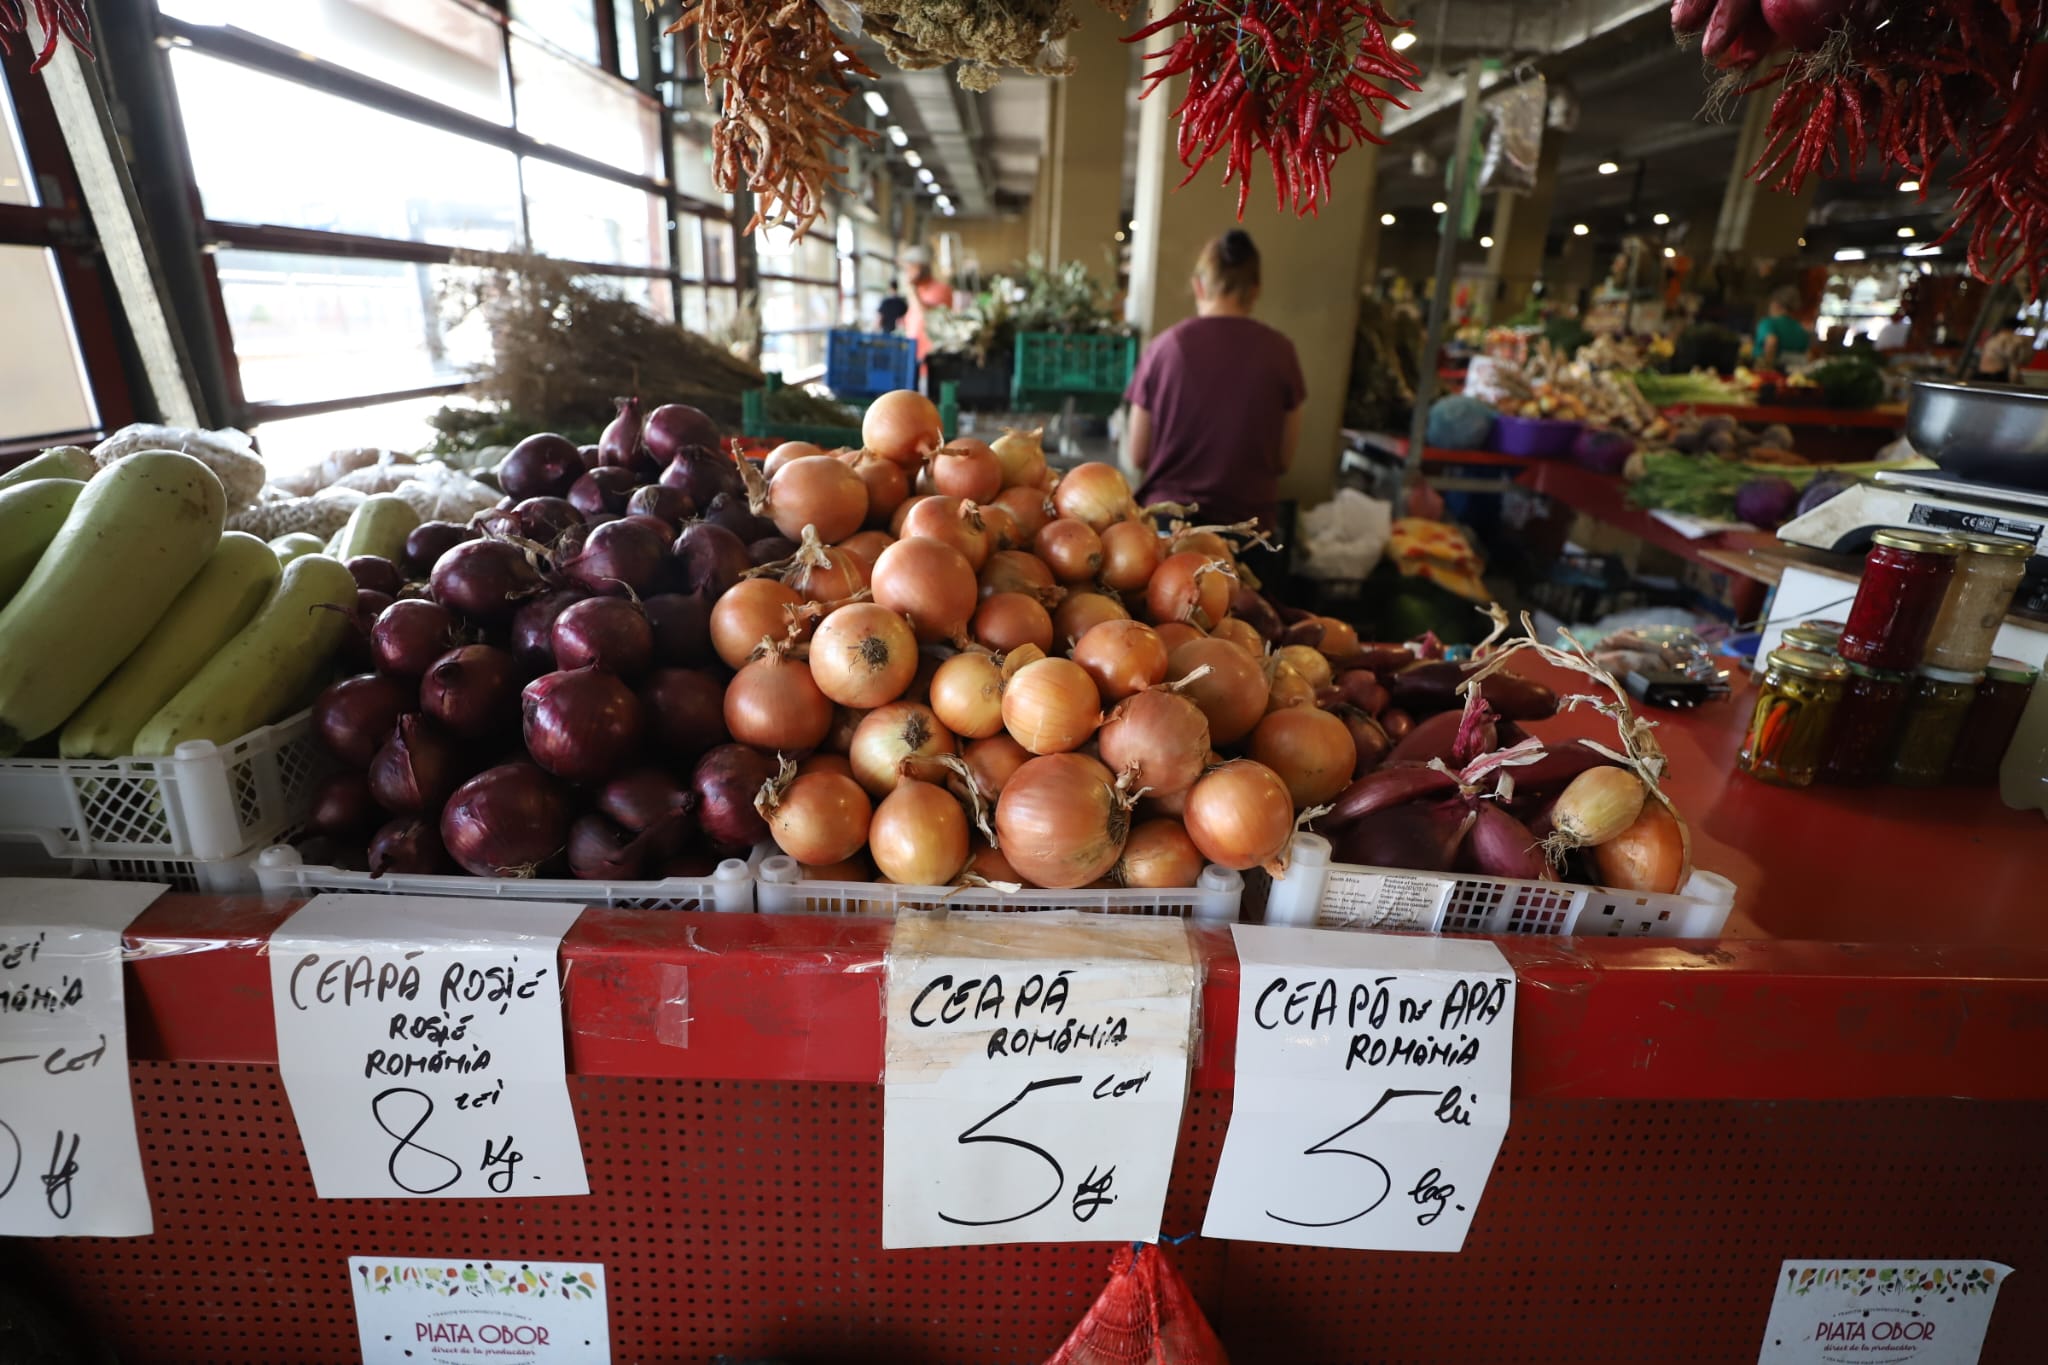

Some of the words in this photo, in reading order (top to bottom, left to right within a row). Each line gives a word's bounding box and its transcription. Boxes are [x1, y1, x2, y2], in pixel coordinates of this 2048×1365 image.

[372, 1087, 462, 1195] 8
[938, 1075, 1083, 1227] 5
[1265, 1088, 1443, 1227] 5
[416, 1322, 475, 1343] PIATA
[478, 1324, 550, 1345] OBOR
[1815, 1321, 1866, 1341] PIATA
[1871, 1321, 1936, 1341] OBOR
[460, 1346, 471, 1355] de
[472, 1346, 484, 1355] la
[1849, 1344, 1860, 1352] de
[1860, 1343, 1870, 1352] la
